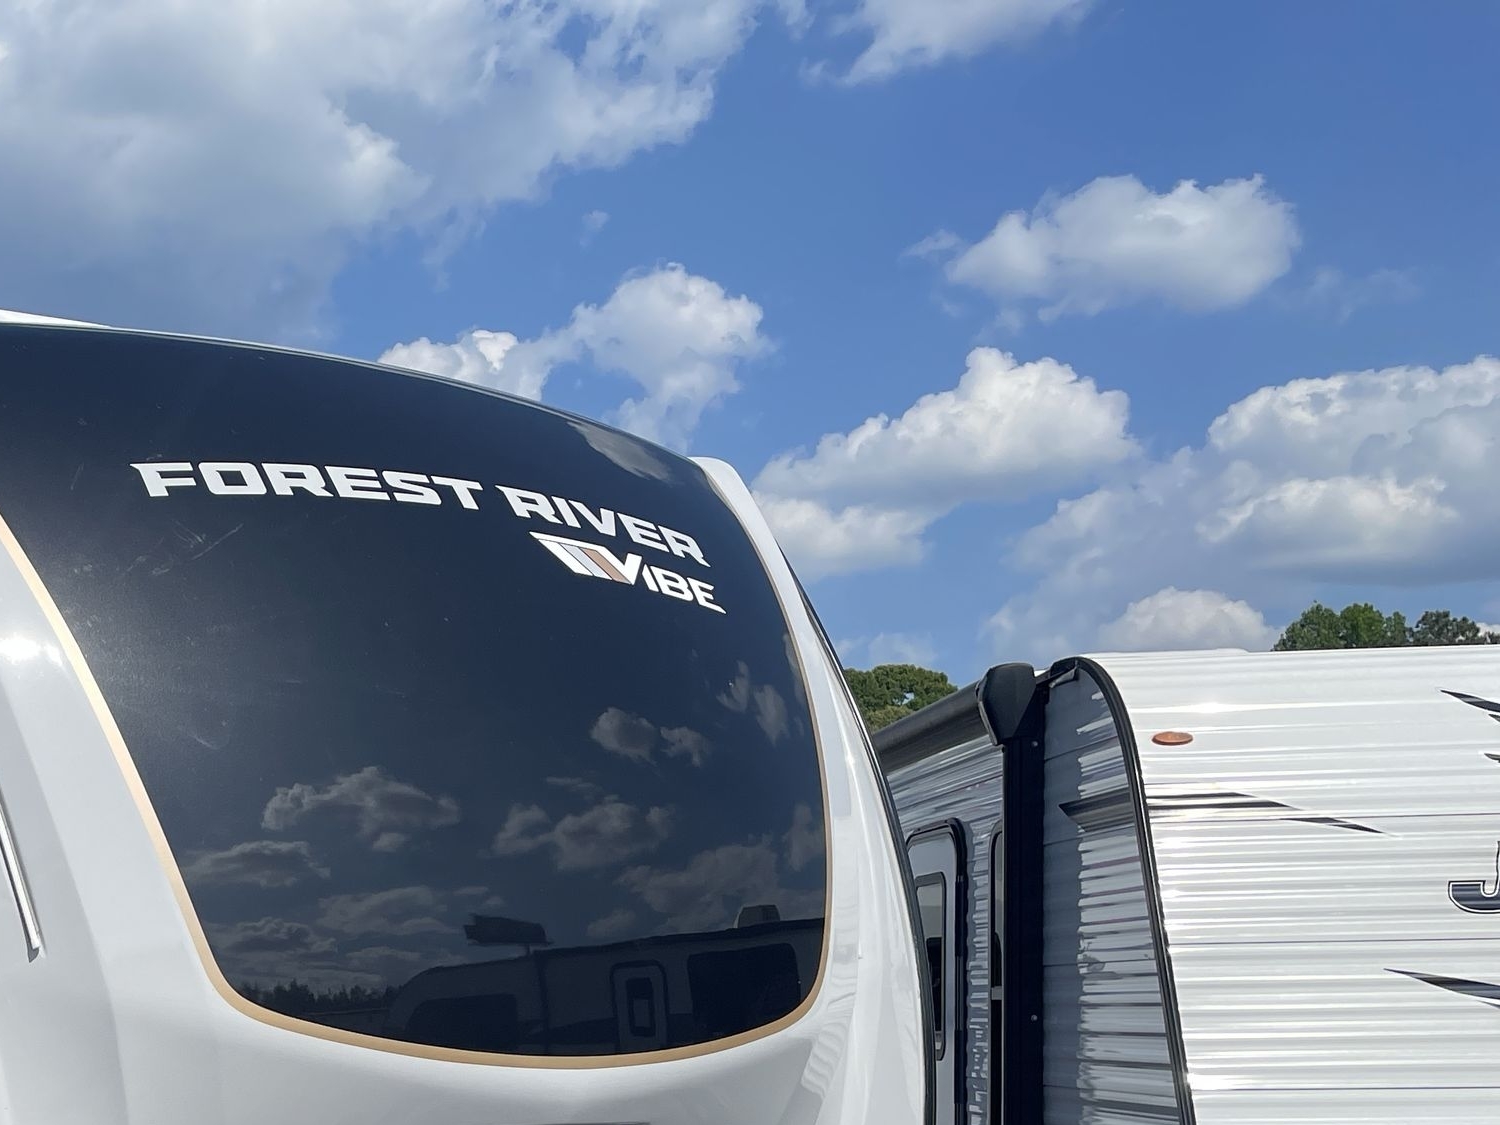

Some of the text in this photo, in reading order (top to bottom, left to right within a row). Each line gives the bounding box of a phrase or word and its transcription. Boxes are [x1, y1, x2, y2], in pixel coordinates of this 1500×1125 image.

[129, 461, 712, 568] FOREST RIVER
[529, 531, 727, 614] VIBE
